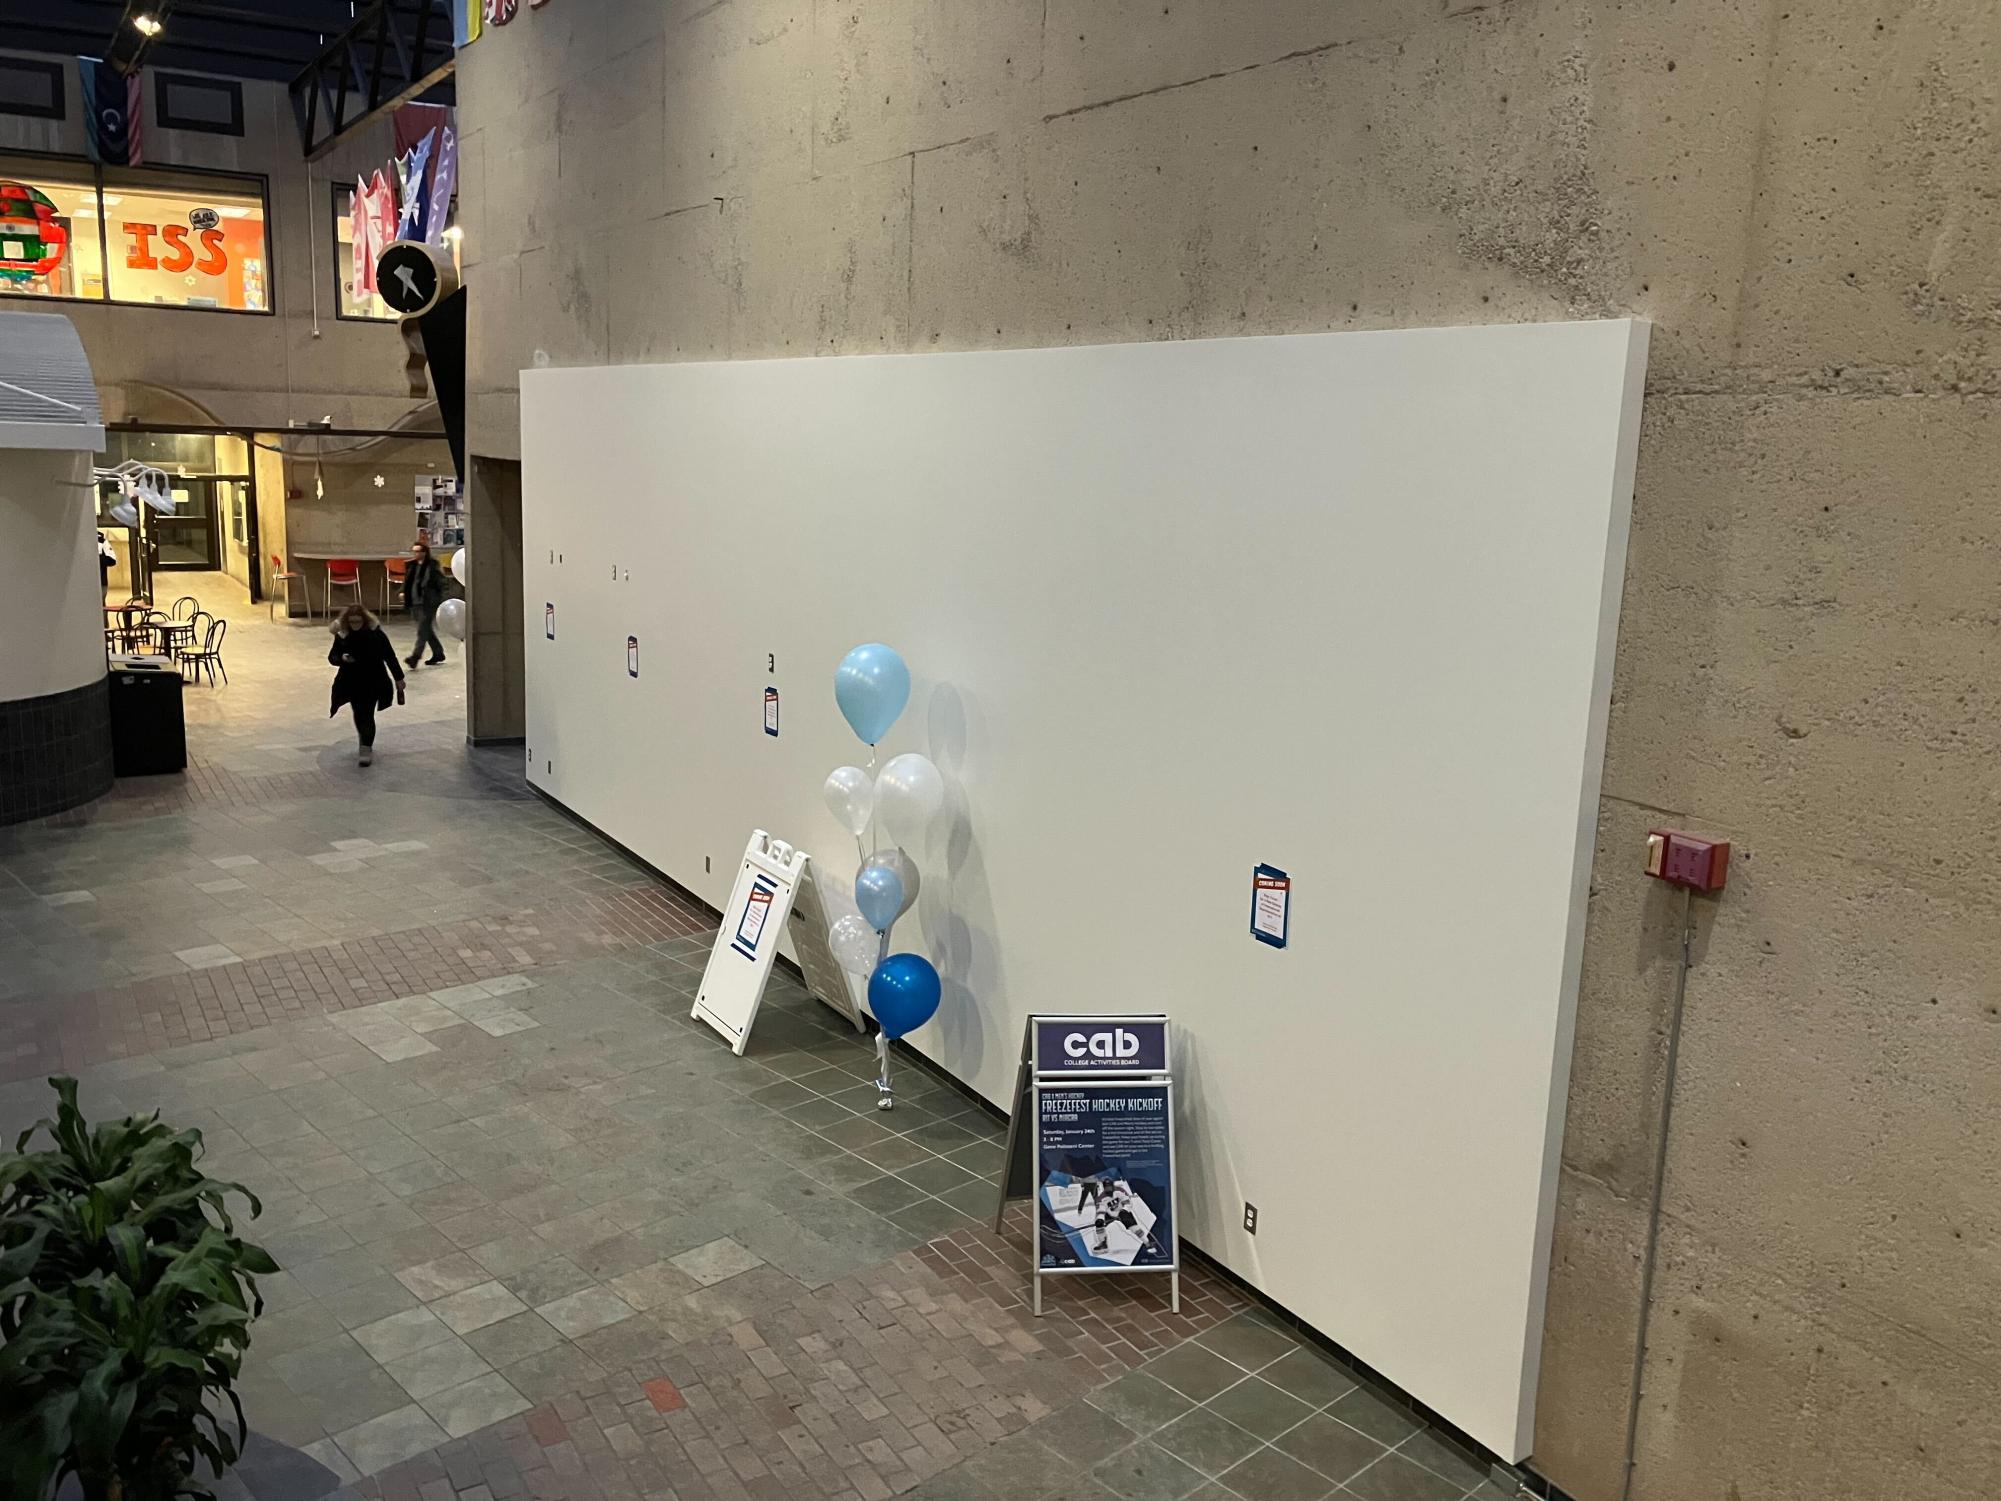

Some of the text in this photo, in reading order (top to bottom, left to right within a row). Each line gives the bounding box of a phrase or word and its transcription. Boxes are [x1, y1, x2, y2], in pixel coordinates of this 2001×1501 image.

[122, 222, 227, 276] ISS
[1063, 1028, 1140, 1057] cab
[1042, 1098, 1163, 1112] FREEZEFEST HOCKEY KICKOFF
